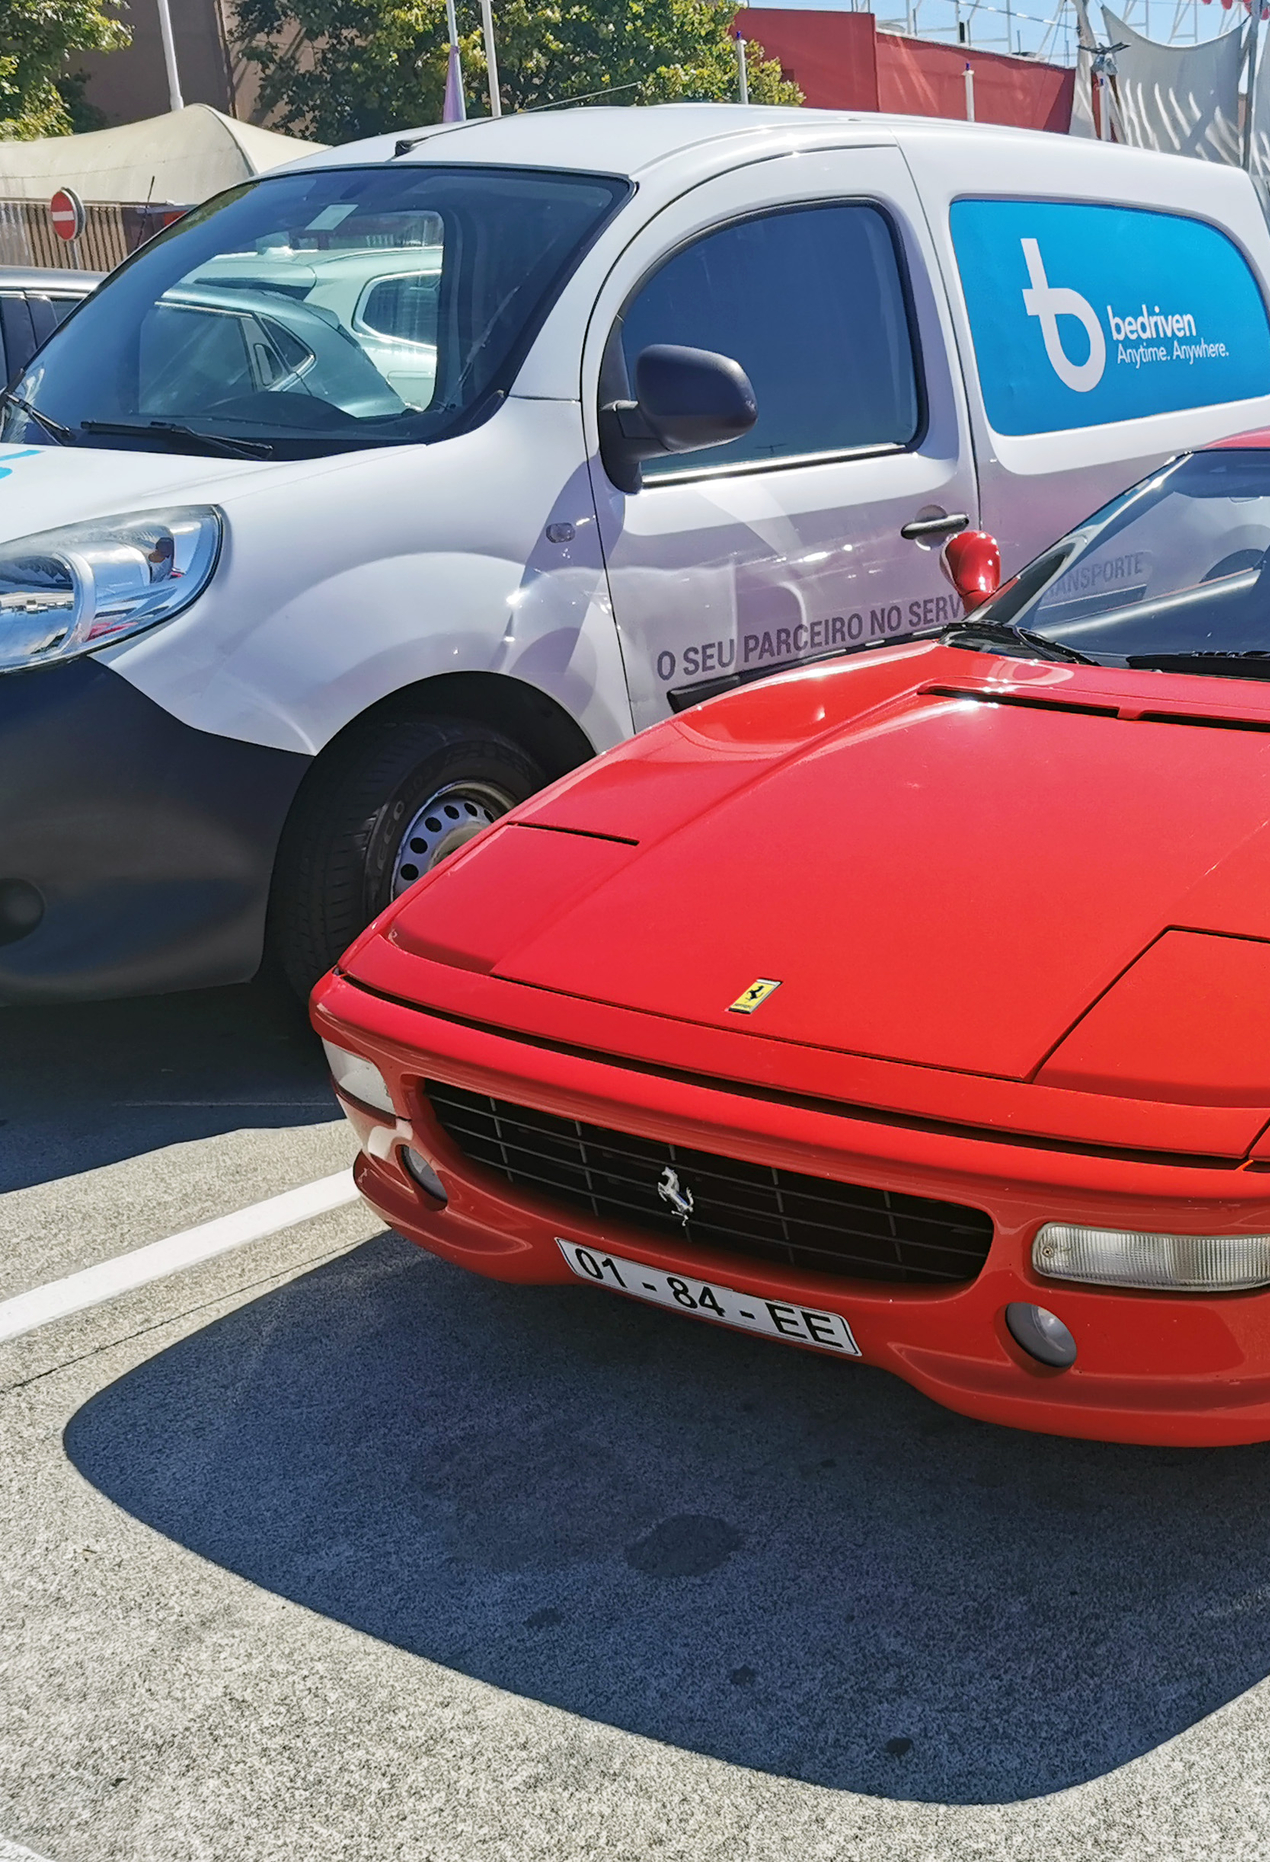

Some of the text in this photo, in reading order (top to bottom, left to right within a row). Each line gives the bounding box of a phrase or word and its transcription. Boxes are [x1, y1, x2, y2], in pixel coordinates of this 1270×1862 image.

[1106, 303, 1197, 341] bedriven
[1117, 337, 1230, 369] Anytime. Anywhere.
[656, 551, 1144, 681] O SEU PARCEIRO NO SERV ANSPORTE
